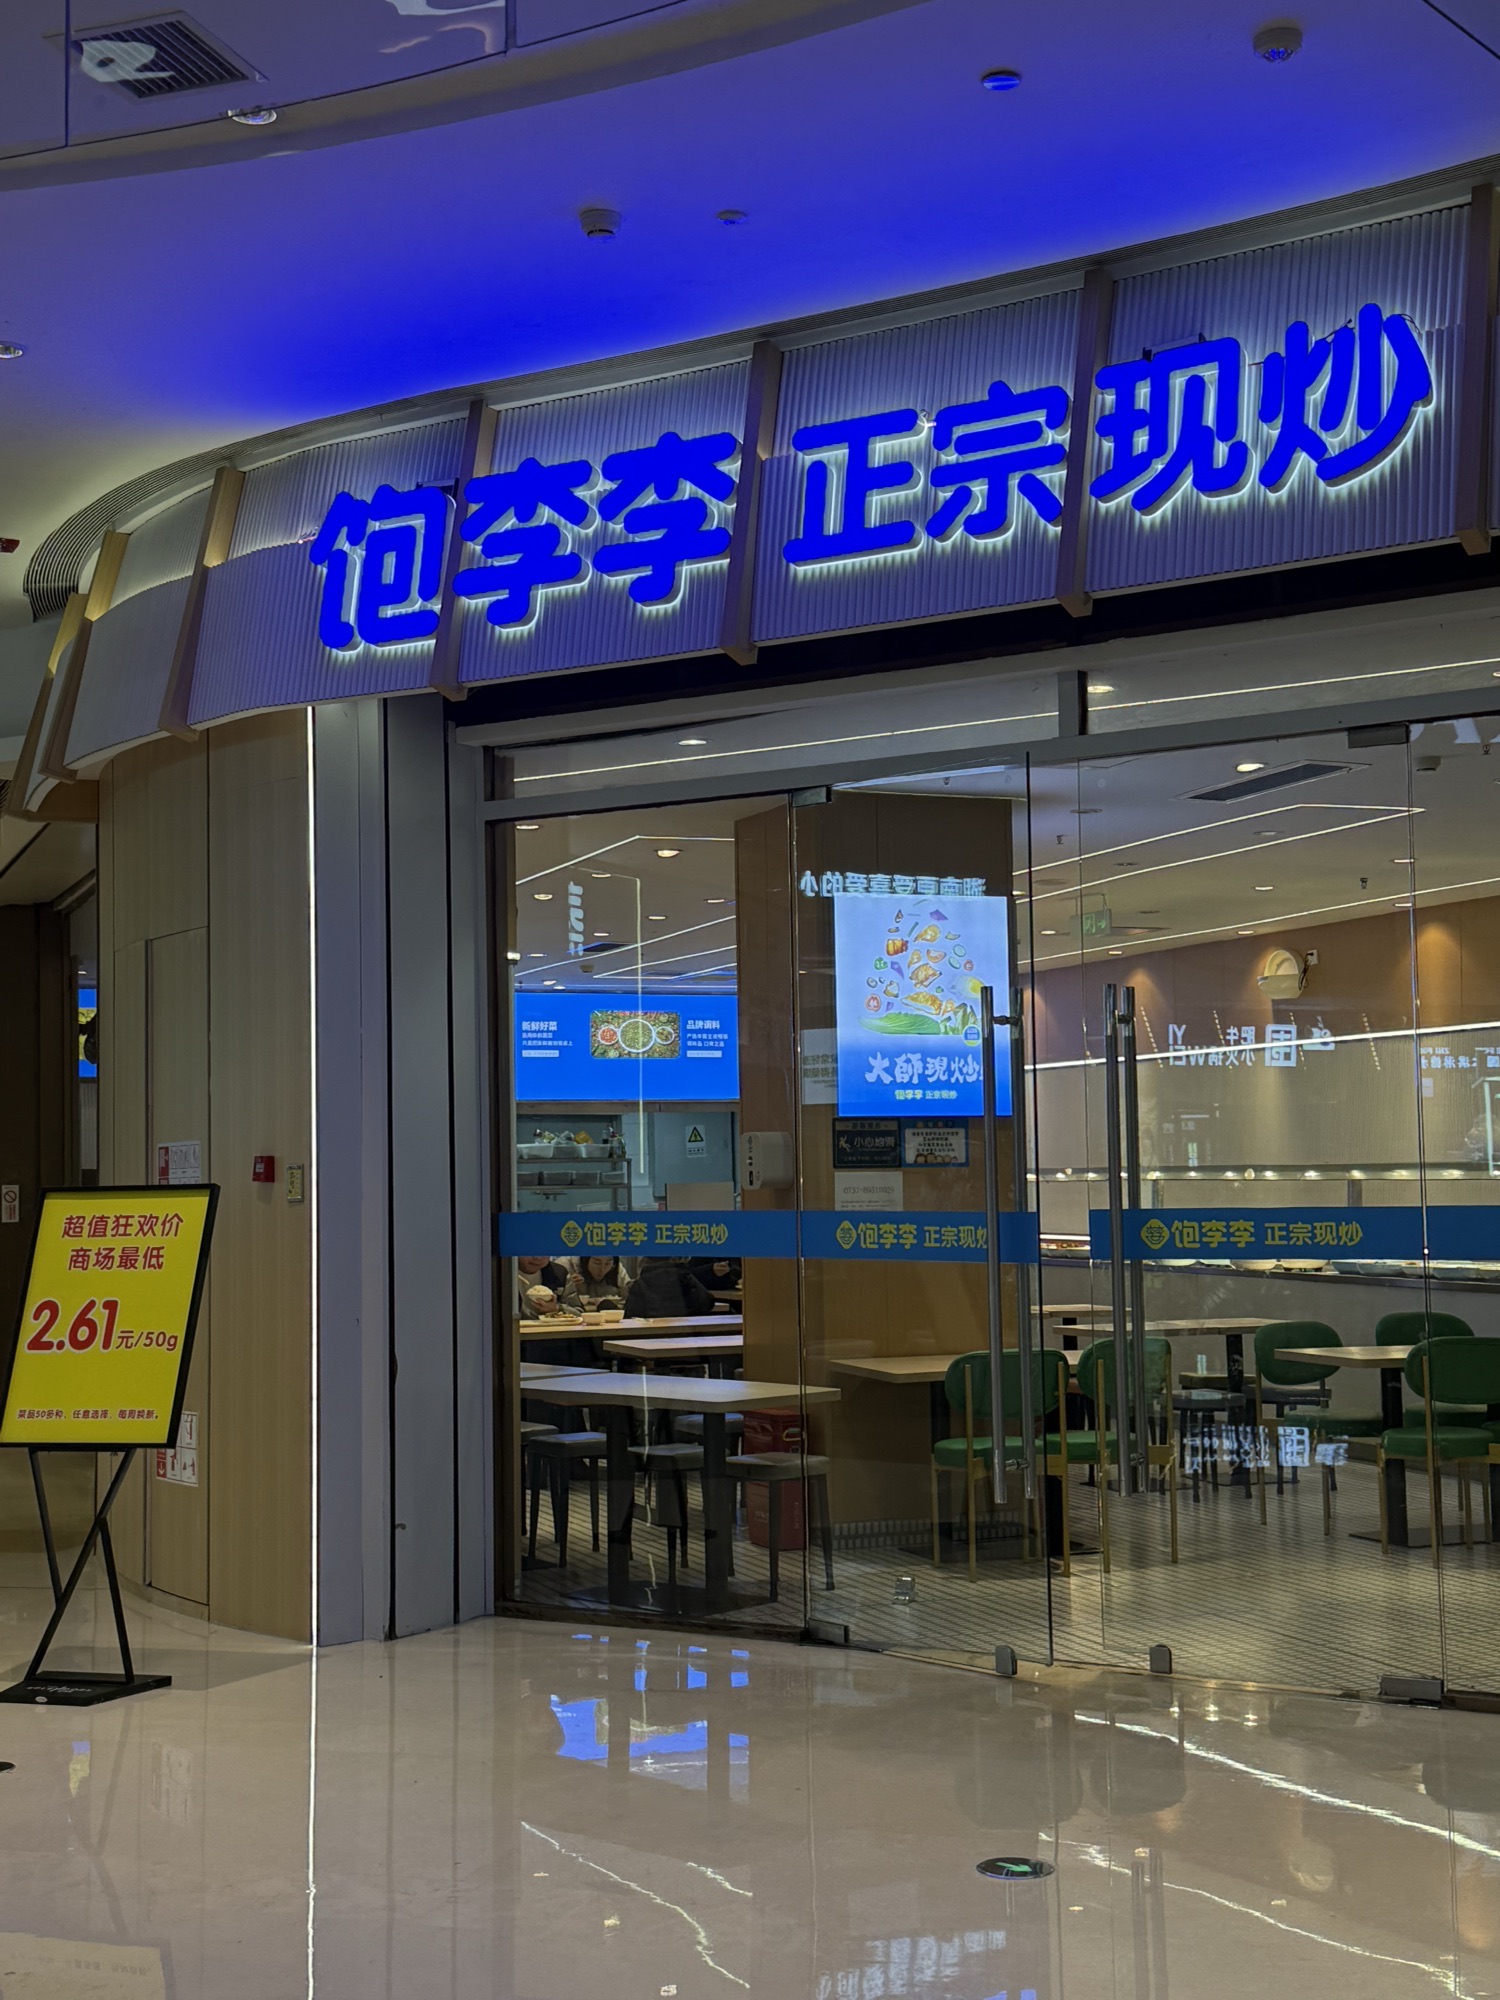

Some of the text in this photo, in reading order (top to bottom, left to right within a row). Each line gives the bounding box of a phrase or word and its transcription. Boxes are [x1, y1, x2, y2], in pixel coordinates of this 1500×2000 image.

[311, 303, 1432, 651] 饱李李 正宗现炒
[61, 1213, 184, 1239] 超值狂欢价
[584, 1222, 729, 1246] 饱李李 正宗现炒
[858, 1224, 918, 1250] 饱李李
[1171, 1220, 1363, 1248] 饱李李 正宗现炒
[67, 1246, 166, 1271] 商场最低
